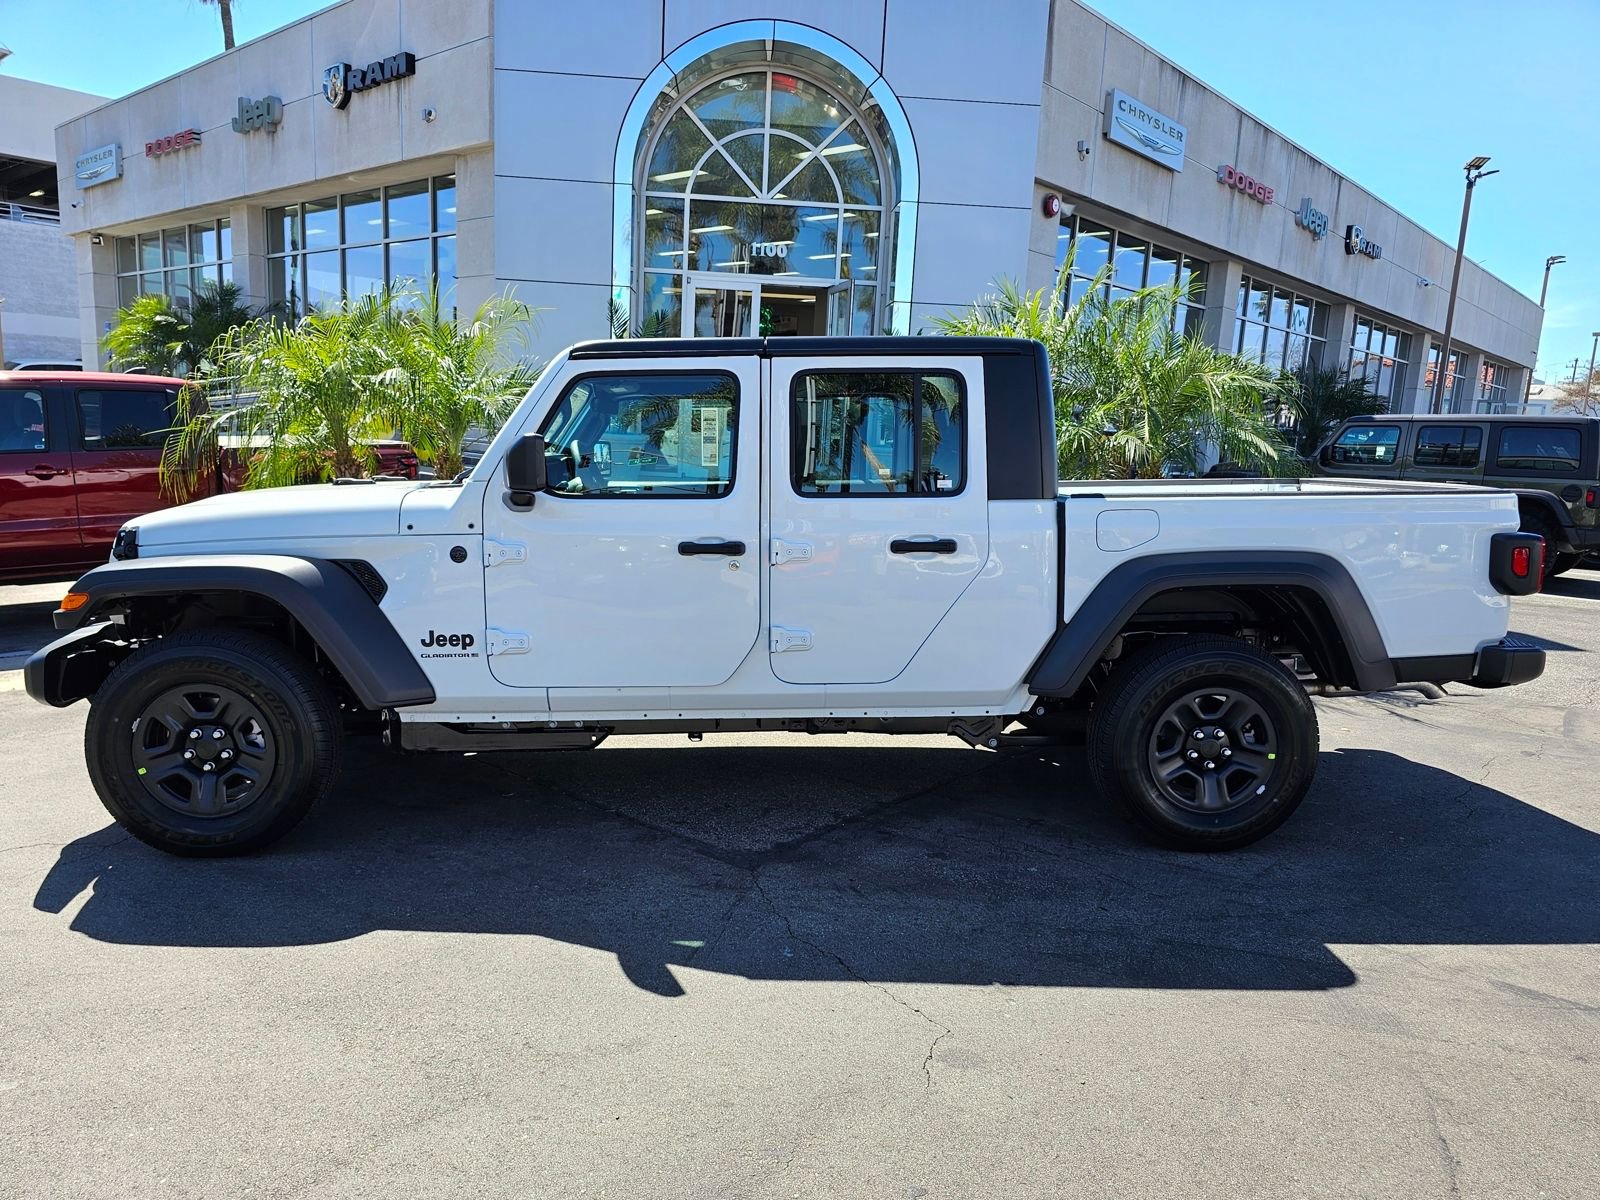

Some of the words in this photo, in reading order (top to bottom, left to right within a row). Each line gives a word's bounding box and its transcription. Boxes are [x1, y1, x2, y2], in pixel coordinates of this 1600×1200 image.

[347, 52, 408, 92] RAM
[232, 95, 282, 134] Jeep
[1117, 99, 1184, 143] CHRYSLER
[76, 149, 113, 168] CHRYSLER
[145, 129, 196, 158] DODGE
[1224, 165, 1274, 204] DODGE
[1301, 197, 1329, 239] Jeep
[750, 241, 788, 258] 1100
[1360, 237, 1383, 259] RAM
[420, 629, 475, 650] Jeep
